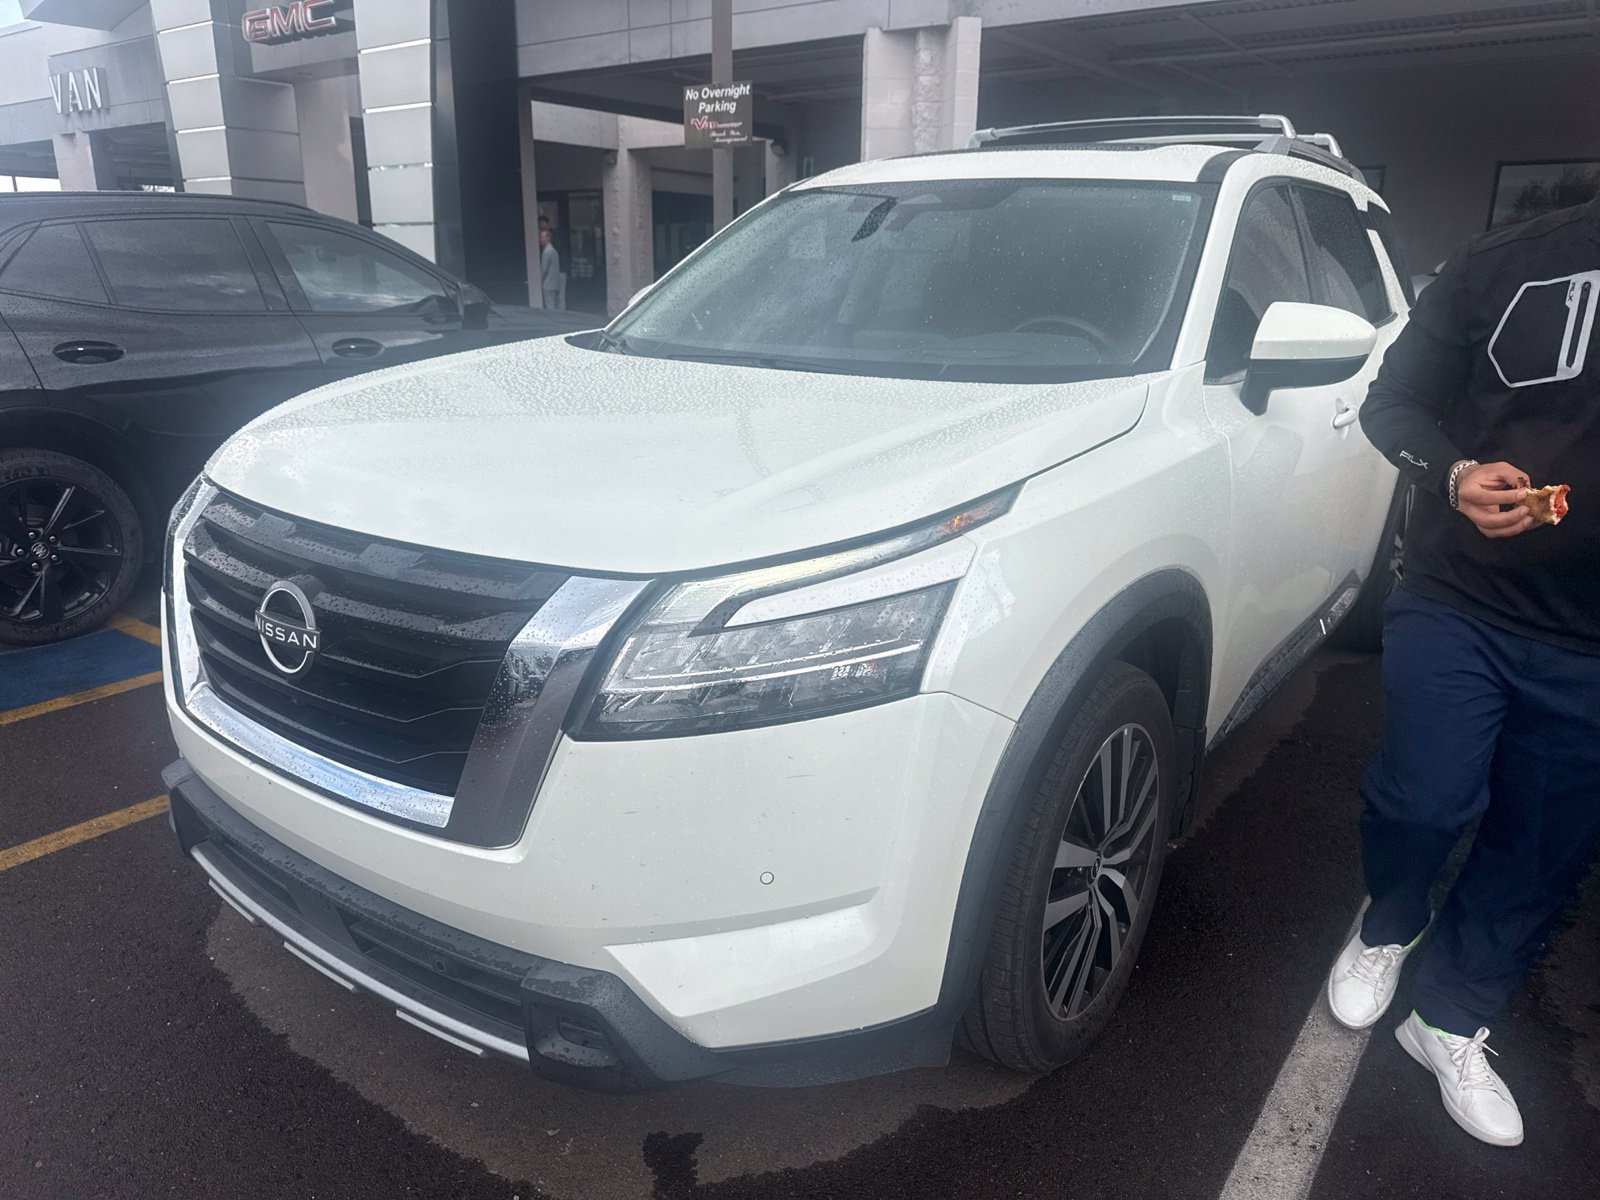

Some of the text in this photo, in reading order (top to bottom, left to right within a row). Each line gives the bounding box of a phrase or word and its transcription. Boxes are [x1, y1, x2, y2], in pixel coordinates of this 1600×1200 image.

[242, 0, 336, 41] GMC
[48, 67, 102, 114] VAN
[685, 84, 751, 101] No Overnight
[698, 101, 737, 113] Parking
[255, 614, 317, 649] NISSAN
